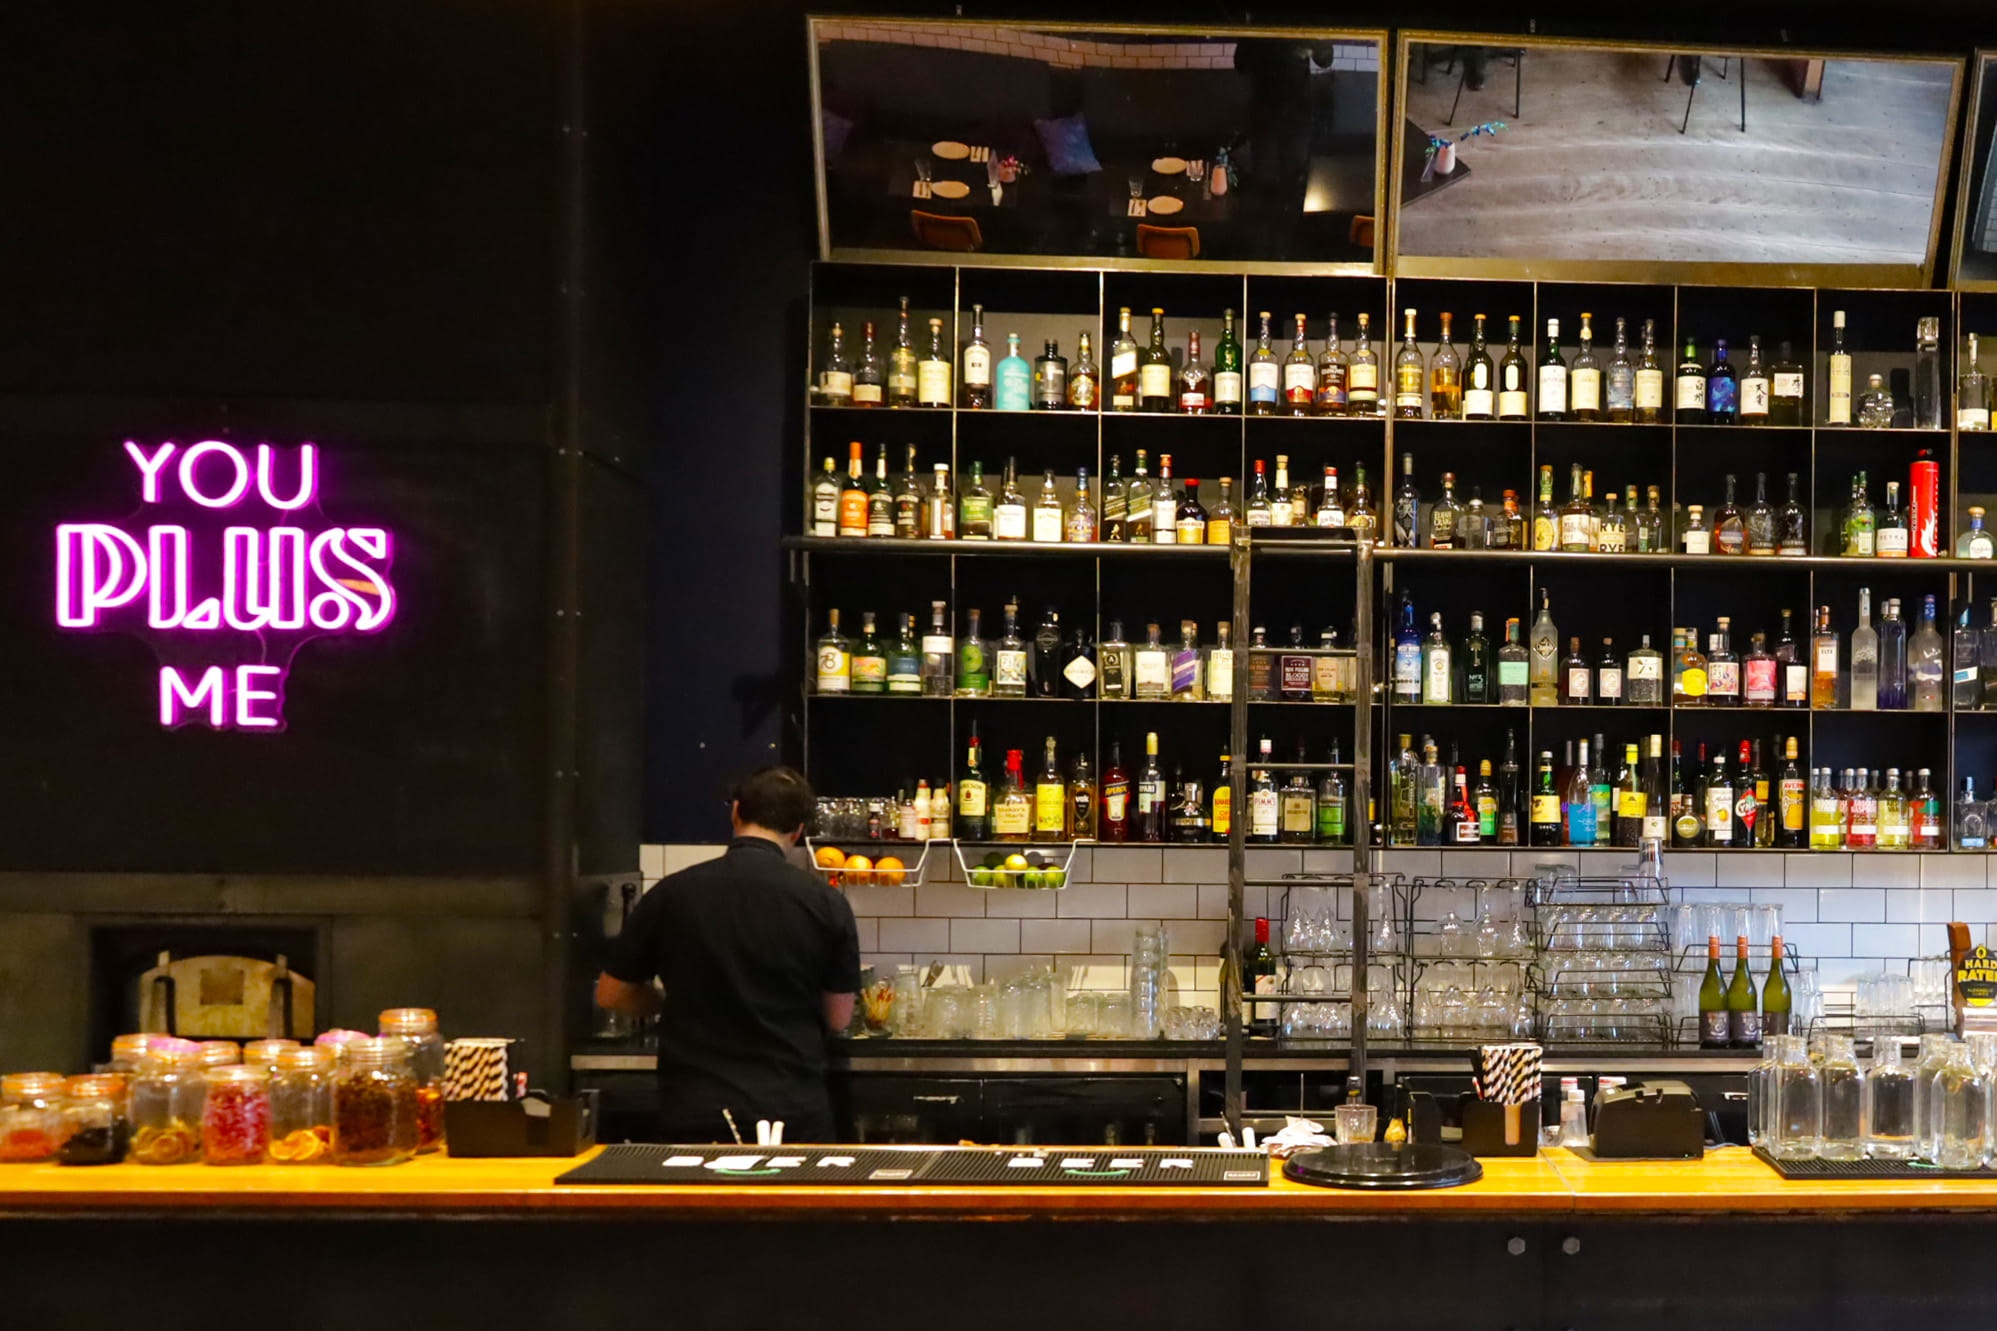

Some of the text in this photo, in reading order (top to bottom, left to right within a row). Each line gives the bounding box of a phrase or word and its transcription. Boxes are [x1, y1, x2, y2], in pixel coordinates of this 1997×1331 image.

[124, 440, 317, 509] YOU
[1599, 523, 1625, 532] RYE
[1599, 543, 1625, 552] RYE
[56, 523, 394, 631] PLUS
[160, 665, 281, 727] ME
[1957, 969, 1997, 982] RATE
